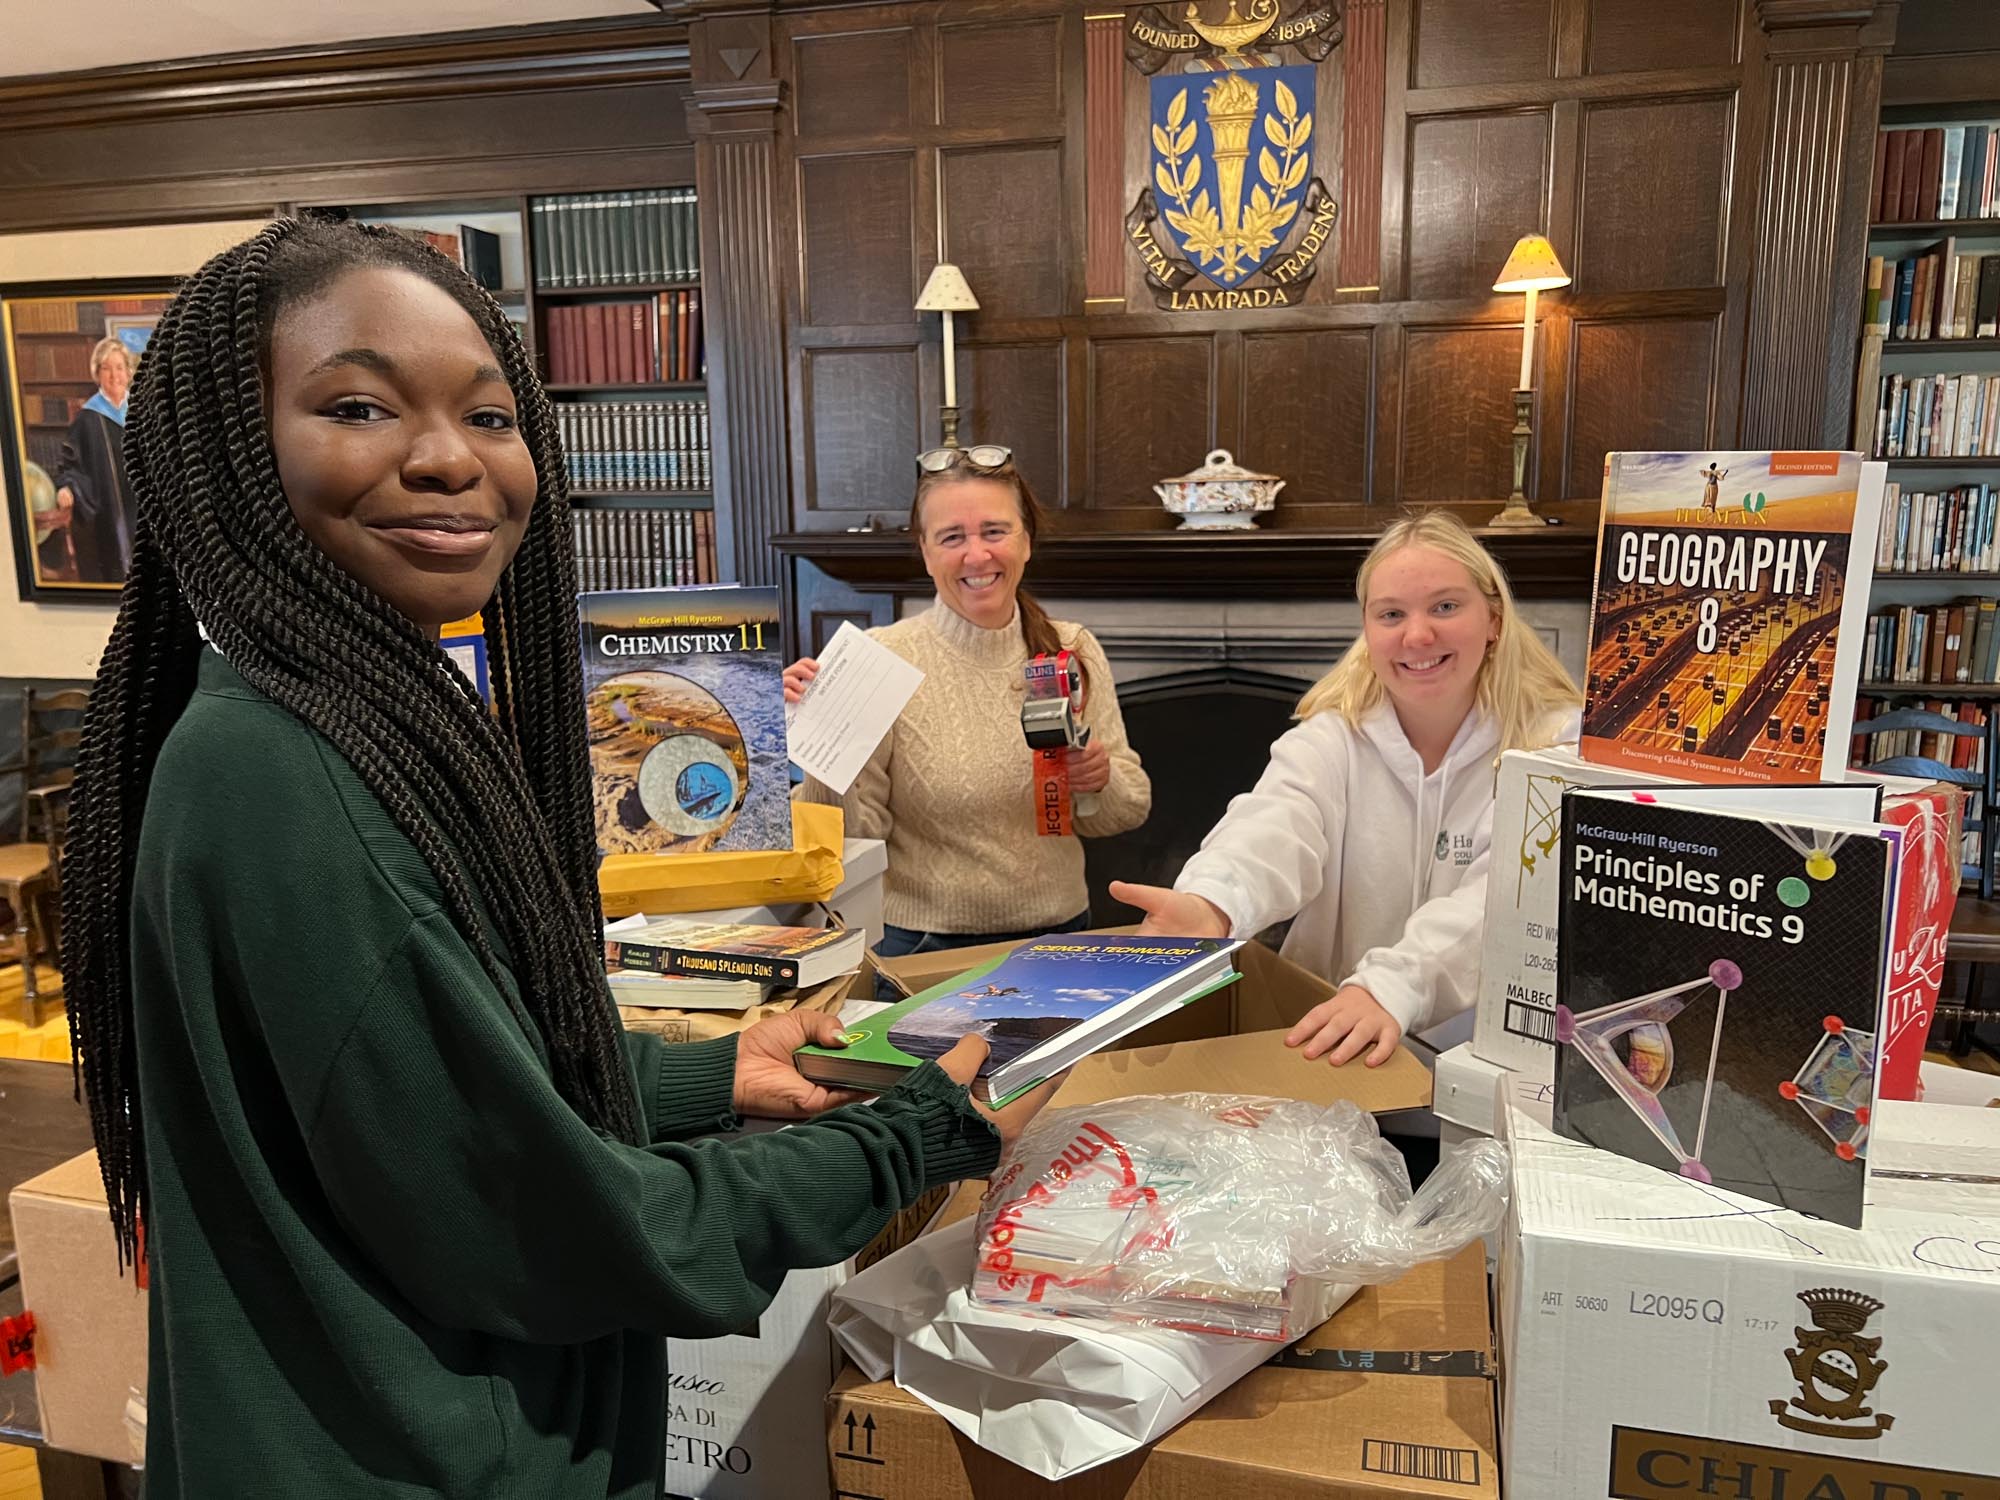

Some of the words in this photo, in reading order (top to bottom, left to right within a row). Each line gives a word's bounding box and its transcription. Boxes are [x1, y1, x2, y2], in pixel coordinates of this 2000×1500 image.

[1131, 21, 1200, 49] FOUNDED
[1278, 20, 1317, 41] 1894
[1131, 222, 1177, 283] VITAI
[1170, 288, 1288, 310] LAMPADA
[1272, 198, 1338, 284] TRADENS
[1775, 463, 1802, 471] SECOND
[1803, 464, 1834, 472] EDITION
[1675, 507, 1770, 525] HUMAN
[1617, 531, 1827, 596] GEOGRAPHY
[638, 615, 690, 626] McGraw-Hill
[691, 613, 723, 626] Ryerson
[1696, 598, 1720, 654] 8
[600, 632, 735, 658] CHEMISTRY
[738, 623, 766, 652] 11
[1622, 747, 1663, 764] Discovering
[1664, 755, 1689, 767] Global
[1690, 758, 1721, 773] Systems
[1722, 765, 1737, 775] and
[1738, 767, 1772, 781] Patterns
[1576, 823, 1656, 848] McGraw-Hill
[1658, 836, 1718, 857] Ryerson
[1575, 844, 1720, 895] Principles
[1729, 873, 1763, 902] of
[1573, 875, 1773, 940] Mathematics
[1781, 916, 1804, 944] 9
[1526, 922, 1543, 938] RED
[1011, 952, 1188, 965] PERSPECTIVES
[1029, 944, 1087, 953] SCIENCE
[1102, 946, 1202, 956] TECHNOLOGY
[681, 955, 718, 972] THOUSAND
[718, 959, 754, 975] SPLENDID
[754, 963, 773, 978] SUNS
[1507, 984, 1553, 1008] MALBEC
[1575, 1295, 1609, 1312] 50630
[1744, 1318, 1779, 1333] 17:17
[696, 1407, 716, 1428] DI
[666, 1432, 752, 1475] ETRO
